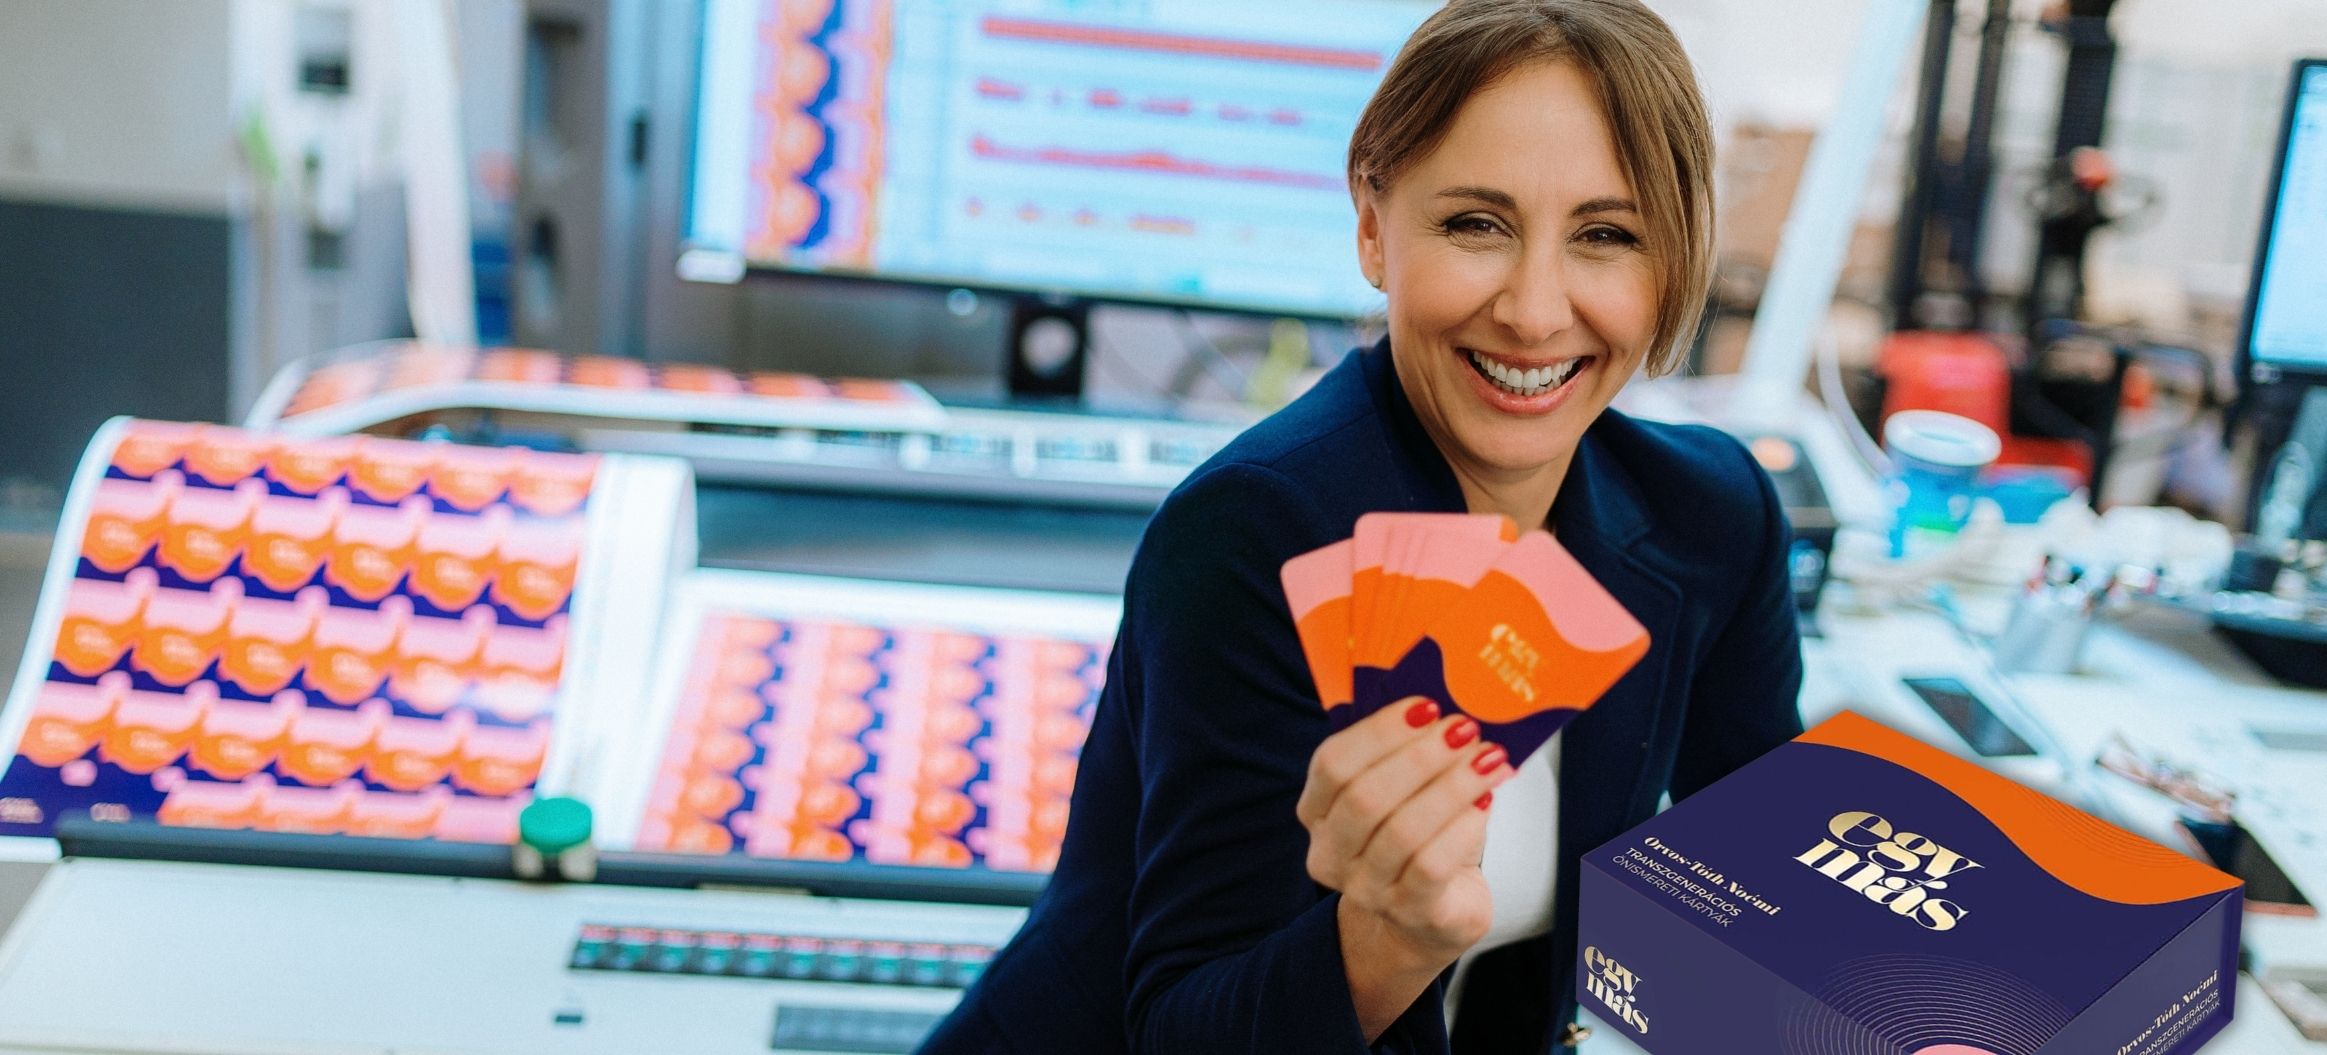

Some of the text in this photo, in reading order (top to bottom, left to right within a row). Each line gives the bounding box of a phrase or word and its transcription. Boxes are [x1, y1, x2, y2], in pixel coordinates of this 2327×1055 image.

[1625, 847, 1742, 917] TRANSZGENERÁCIÓS
[1644, 836, 1782, 916] Orvos-Tóth Noémi
[1792, 838, 1970, 931] más
[1828, 811, 1985, 890] egy
[1612, 854, 1733, 928] ÖNISMERETI KÁRTYÁK
[1584, 945, 1643, 1003] egy
[1586, 970, 1649, 1034] más
[2182, 969, 2217, 1007] Noémi
